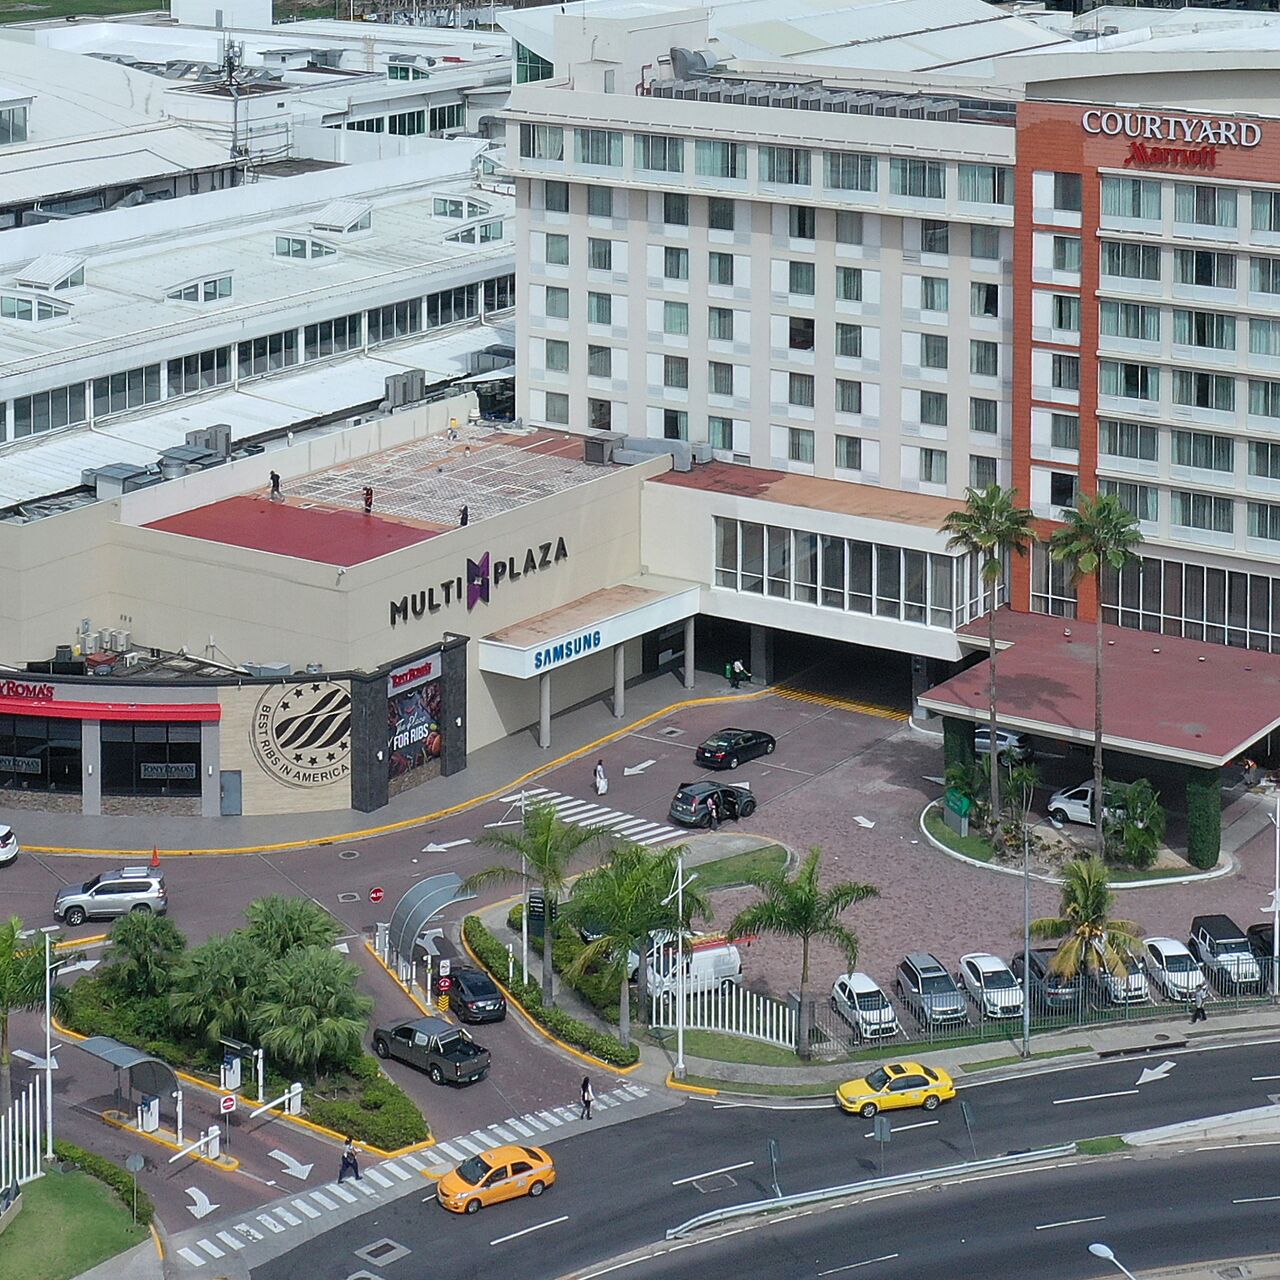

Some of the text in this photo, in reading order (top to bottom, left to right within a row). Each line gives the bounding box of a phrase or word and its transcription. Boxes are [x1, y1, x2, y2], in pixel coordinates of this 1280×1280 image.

[1082, 110, 1263, 148] COURTYARD
[1124, 142, 1219, 168] Marriott
[390, 537, 568, 626] MULTI PLAZA
[534, 631, 601, 669] SAMSUNG
[258, 704, 349, 782] BEST RIBS IN AMERICA
[393, 723, 429, 751] FOR RIBS
